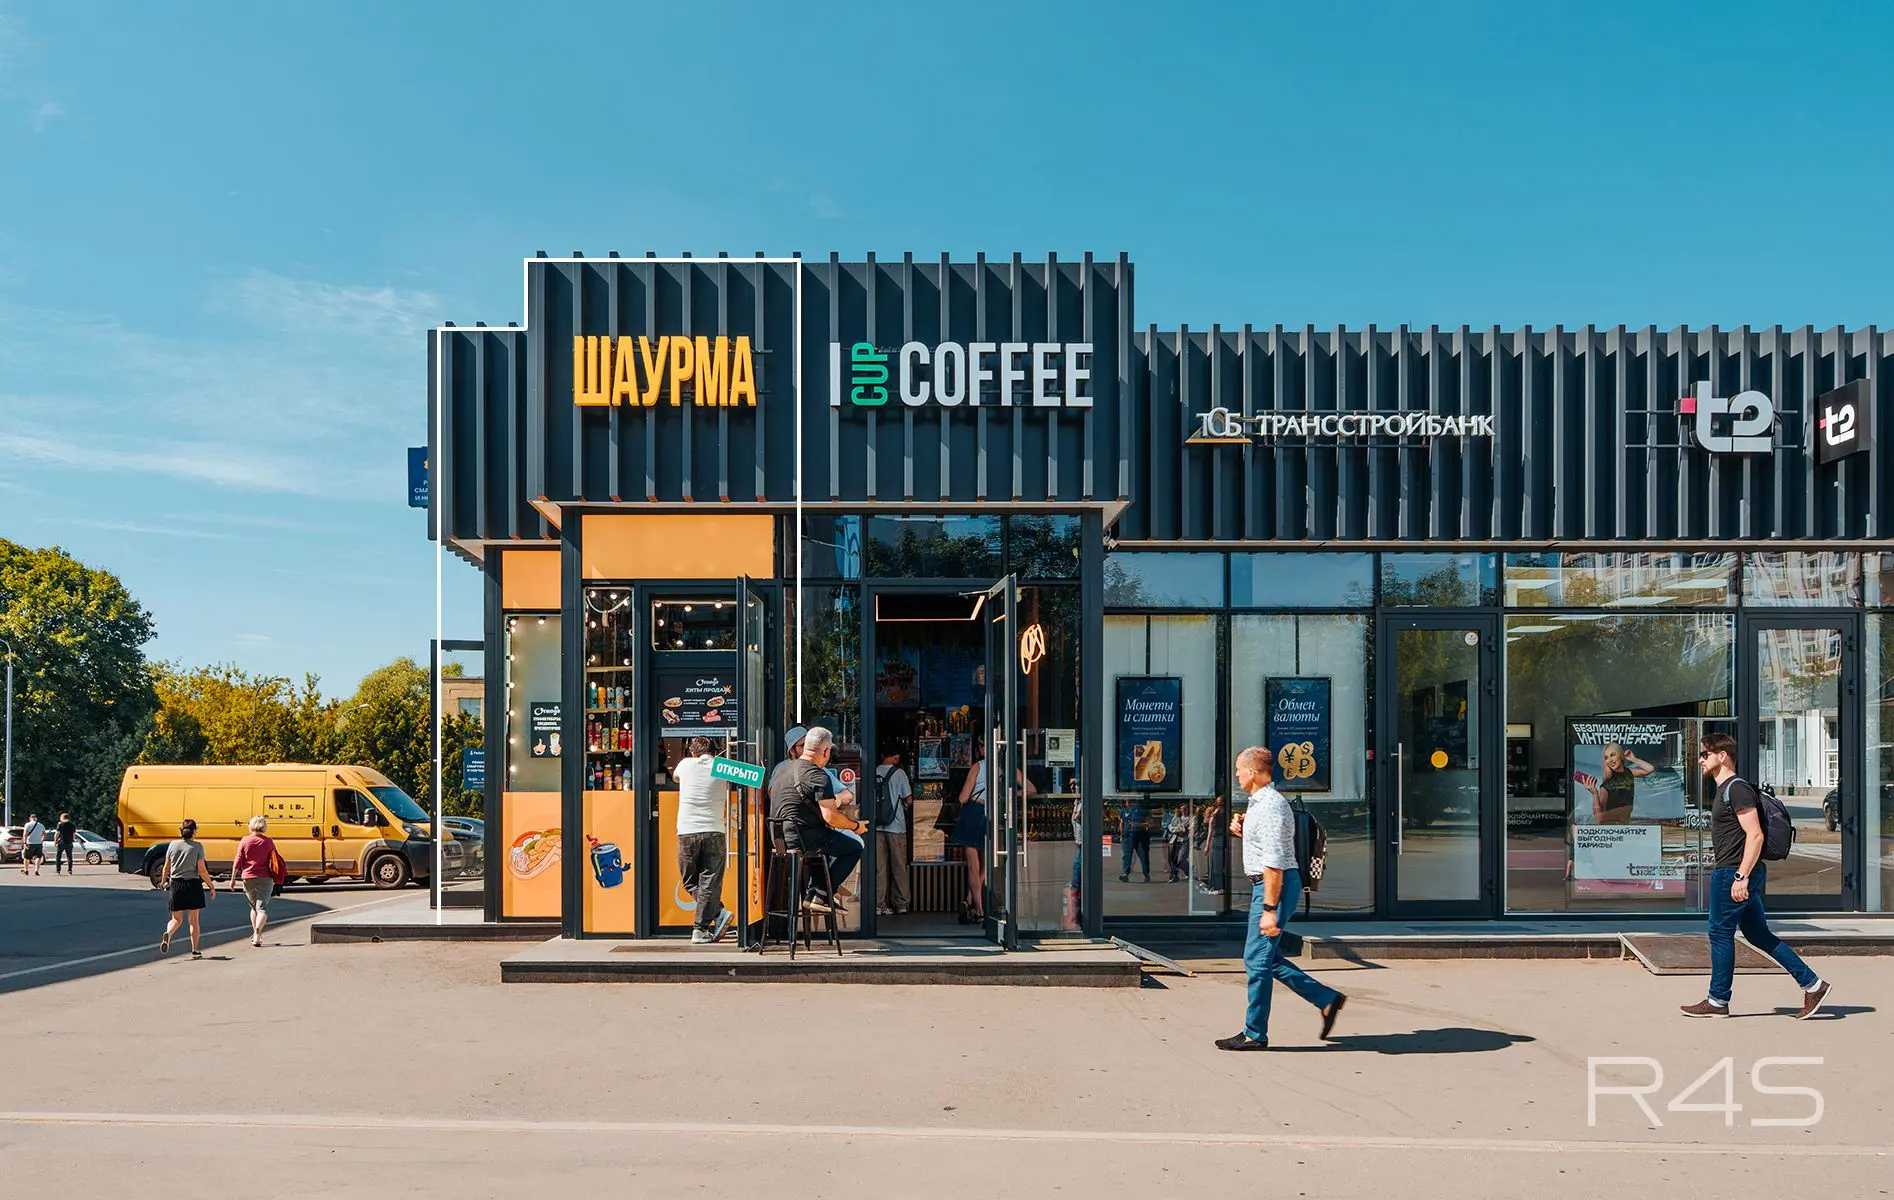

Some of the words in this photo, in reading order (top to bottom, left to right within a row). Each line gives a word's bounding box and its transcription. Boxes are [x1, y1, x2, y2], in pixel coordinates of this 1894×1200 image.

[573, 335, 757, 407] ШАУРМА
[829, 342, 841, 406] I
[851, 341, 889, 407] CUP
[899, 341, 1094, 407] COFFEE
[1255, 411, 1497, 437] ТРАНССТРОЙБАНК
[1696, 380, 1775, 453] t2
[1825, 404, 1856, 446] t2
[1125, 699, 1174, 711] Монеты
[1278, 698, 1316, 711] Обмен
[1123, 714, 1131, 722] и
[1132, 713, 1175, 722] слитки
[1273, 713, 1320, 722] валюты
[716, 763, 759, 782] ОТКРЫТО
